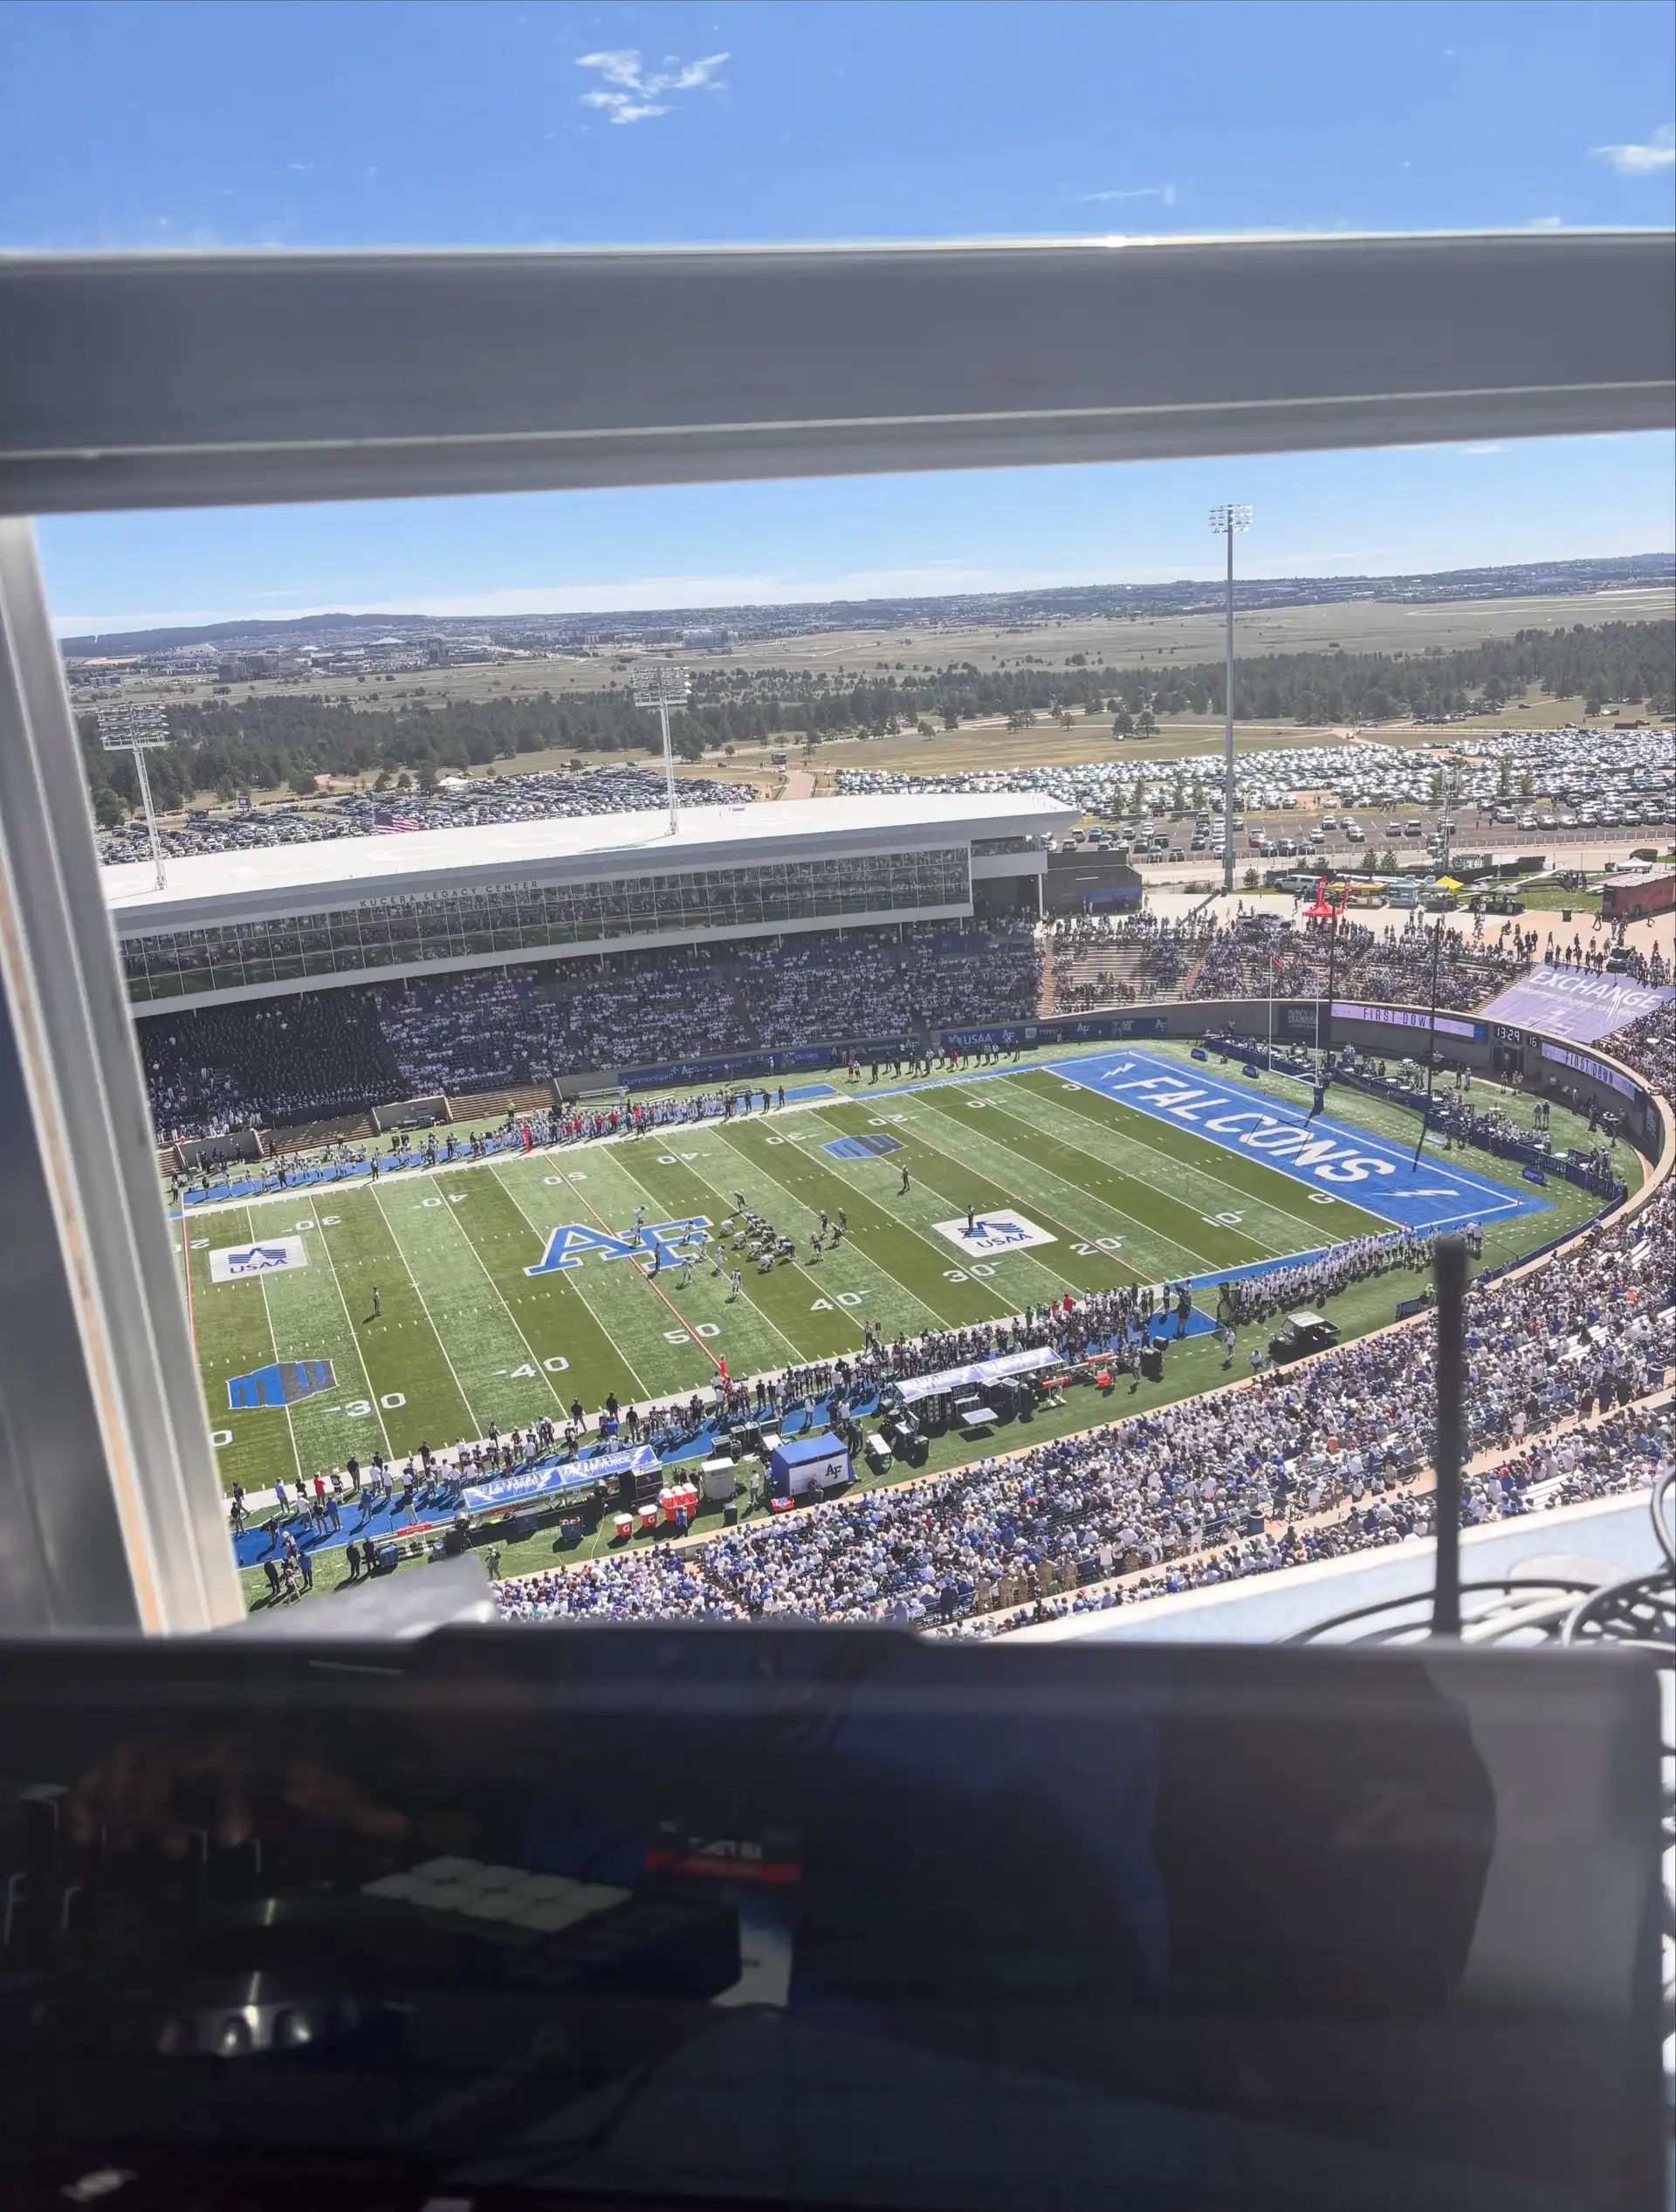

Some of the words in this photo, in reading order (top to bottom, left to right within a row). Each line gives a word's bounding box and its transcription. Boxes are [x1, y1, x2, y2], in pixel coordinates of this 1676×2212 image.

[361, 895, 416, 907] KUCERA
[424, 887, 477, 899] LEGACY
[485, 881, 538, 893] CENTER
[1529, 972, 1664, 1008] EXCHANGE
[1363, 1007, 1395, 1022] FIRST
[963, 1033, 993, 1045] USAA
[1497, 1027, 1520, 1042] 13:29
[1529, 1037, 1537, 1048] 16
[1566, 1052, 1589, 1072] FIRST
[1592, 1063, 1613, 1086] DOWN
[622, 1073, 673, 1086] CommonSpirit
[868, 1114, 908, 1126] 20
[1112, 1076, 1396, 1182] FALCONS
[766, 1132, 807, 1145] 30
[656, 1152, 698, 1164] 40
[543, 1171, 587, 1185] 50
[422, 1193, 468, 1207] 40
[295, 1215, 342, 1231] 30
[1200, 1212, 1241, 1228] 10
[523, 1215, 715, 1276] AF
[977, 1233, 1034, 1248] USAA
[1069, 1237, 1122, 1256] 20
[230, 1258, 288, 1274] USAA
[943, 1264, 996, 1282] 30
[810, 1292, 863, 1311] 40
[663, 1322, 722, 1344] 50
[511, 1357, 570, 1378] 40
[346, 1392, 407, 1417] 30
[825, 1464, 842, 1480] AF
[648, 1515, 656, 1523] G
[622, 1524, 630, 1533] G
